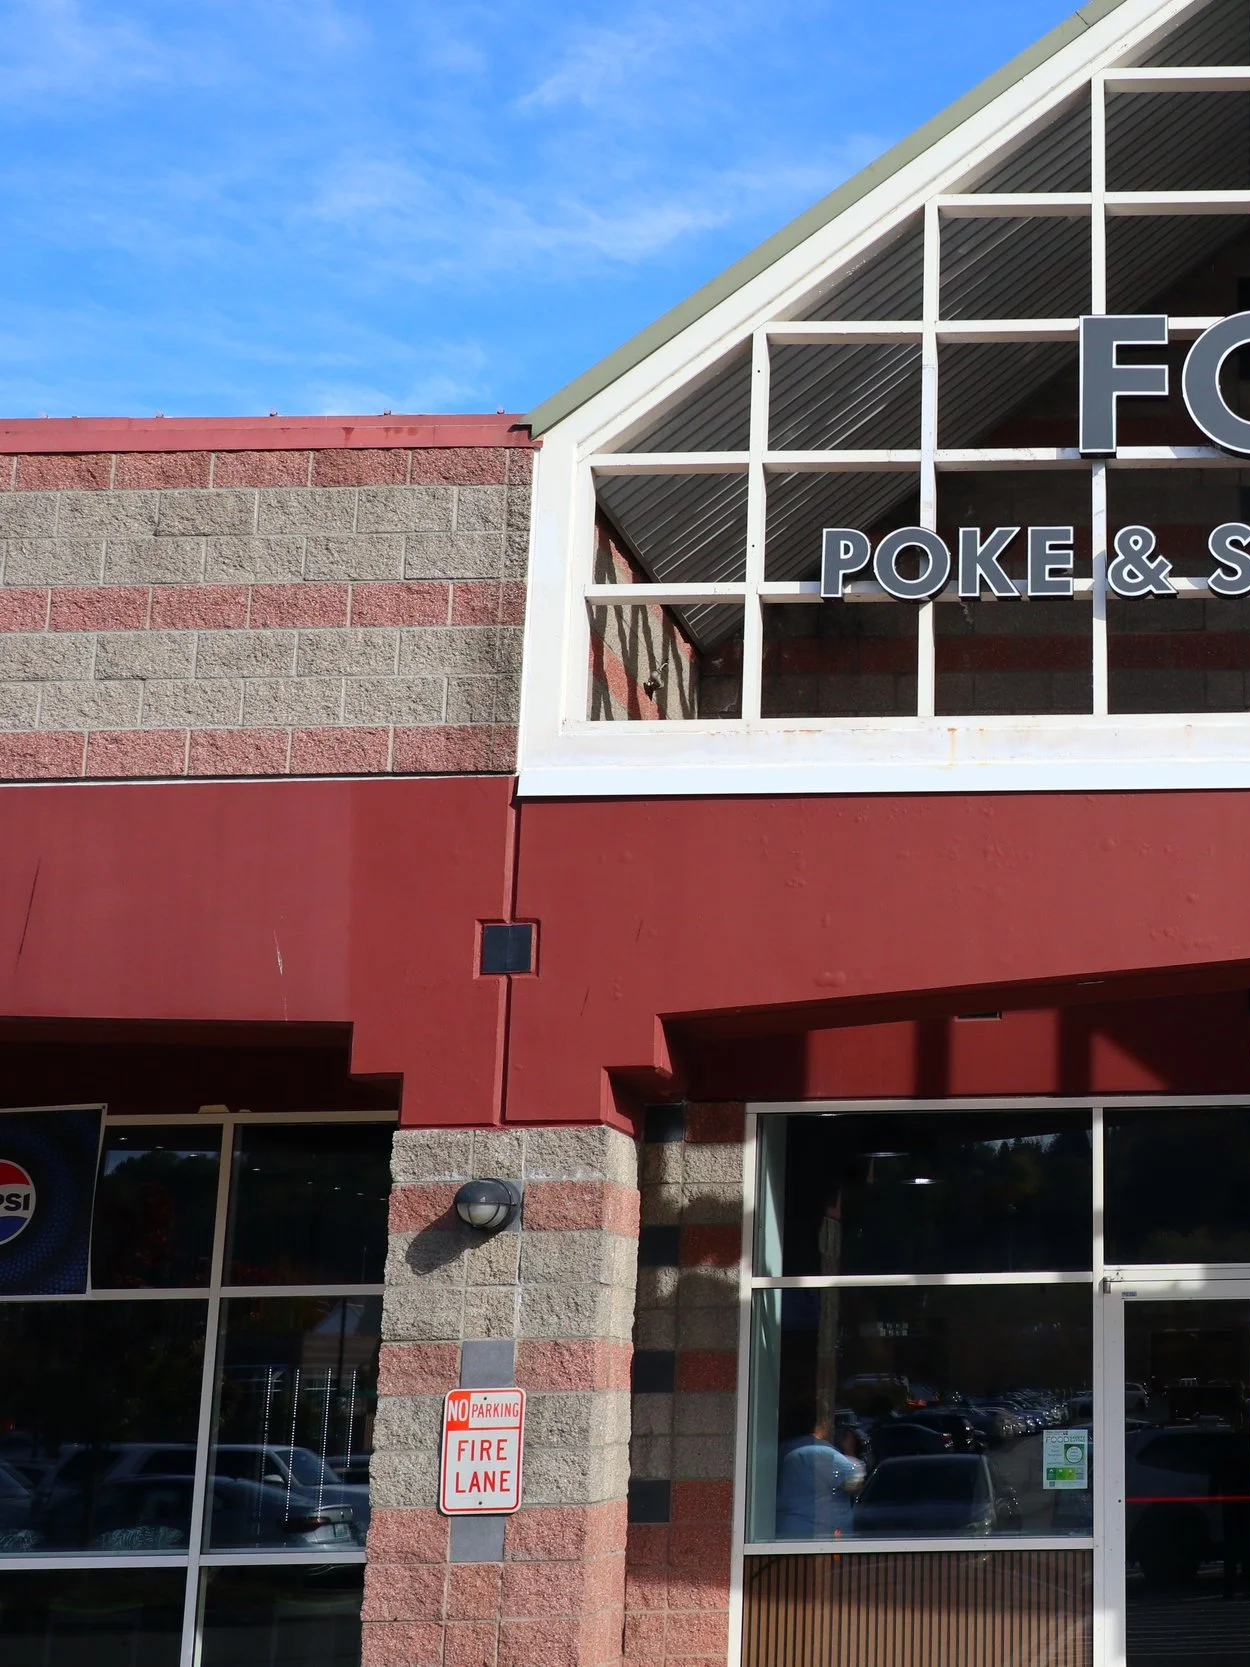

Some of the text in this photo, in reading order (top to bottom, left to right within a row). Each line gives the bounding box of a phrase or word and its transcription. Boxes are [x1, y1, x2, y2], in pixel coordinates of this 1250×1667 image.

[820, 525, 1075, 599] POKE
[1107, 524, 1178, 597] &
[447, 1399, 519, 1422] NO PARKING
[457, 1439, 508, 1462] FIRE
[455, 1470, 511, 1493] LANE
